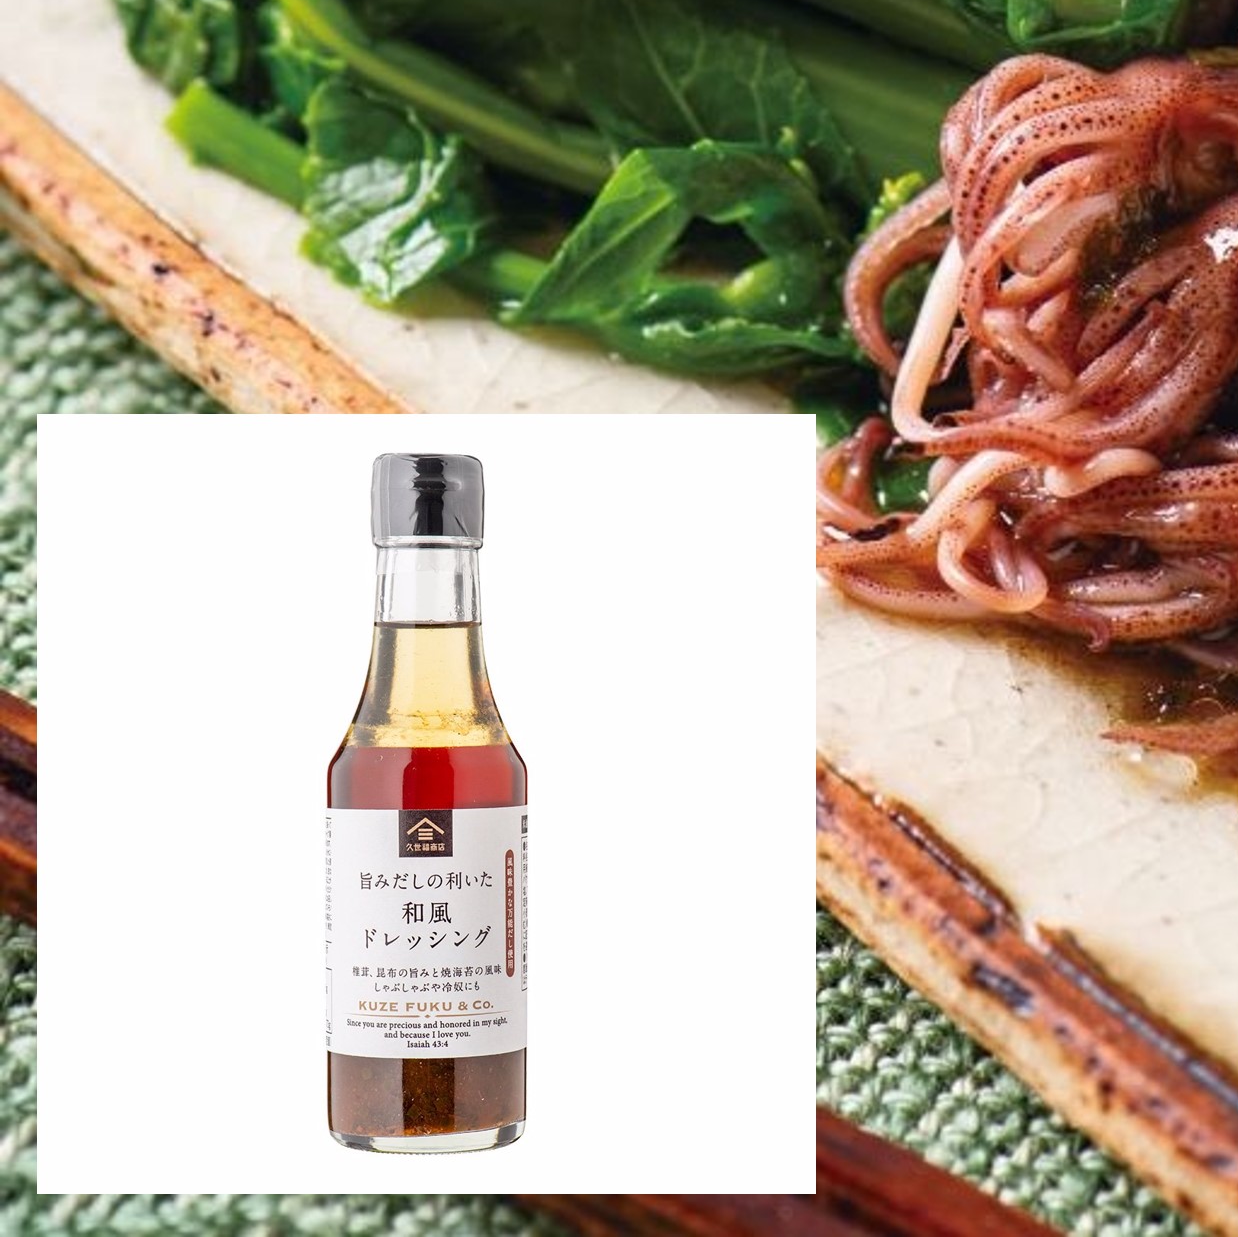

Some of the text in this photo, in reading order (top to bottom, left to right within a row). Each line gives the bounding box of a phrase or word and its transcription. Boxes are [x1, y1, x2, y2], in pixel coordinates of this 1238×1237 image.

[360, 871, 493, 890] 旨みだしの利いた
[401, 901, 452, 925] 和風
[364, 925, 492, 950] ドレッシング
[352, 964, 502, 978] 椎茸、昆布の旨みと焼海苔の風味
[374, 981, 480, 993] しゃぶしゃぶや冷奴にも
[359, 1001, 398, 1012] KUZE
[406, 1002, 452, 1012] FUKU
[458, 1001, 468, 1011] &
[346, 1018, 361, 1027] Since
[389, 1022, 421, 1030] precious
[423, 1021, 438, 1029] and
[439, 1020, 471, 1028] honored
[455, 1031, 471, 1039] you.
[407, 1040, 449, 1048] Isaiah 43:4
